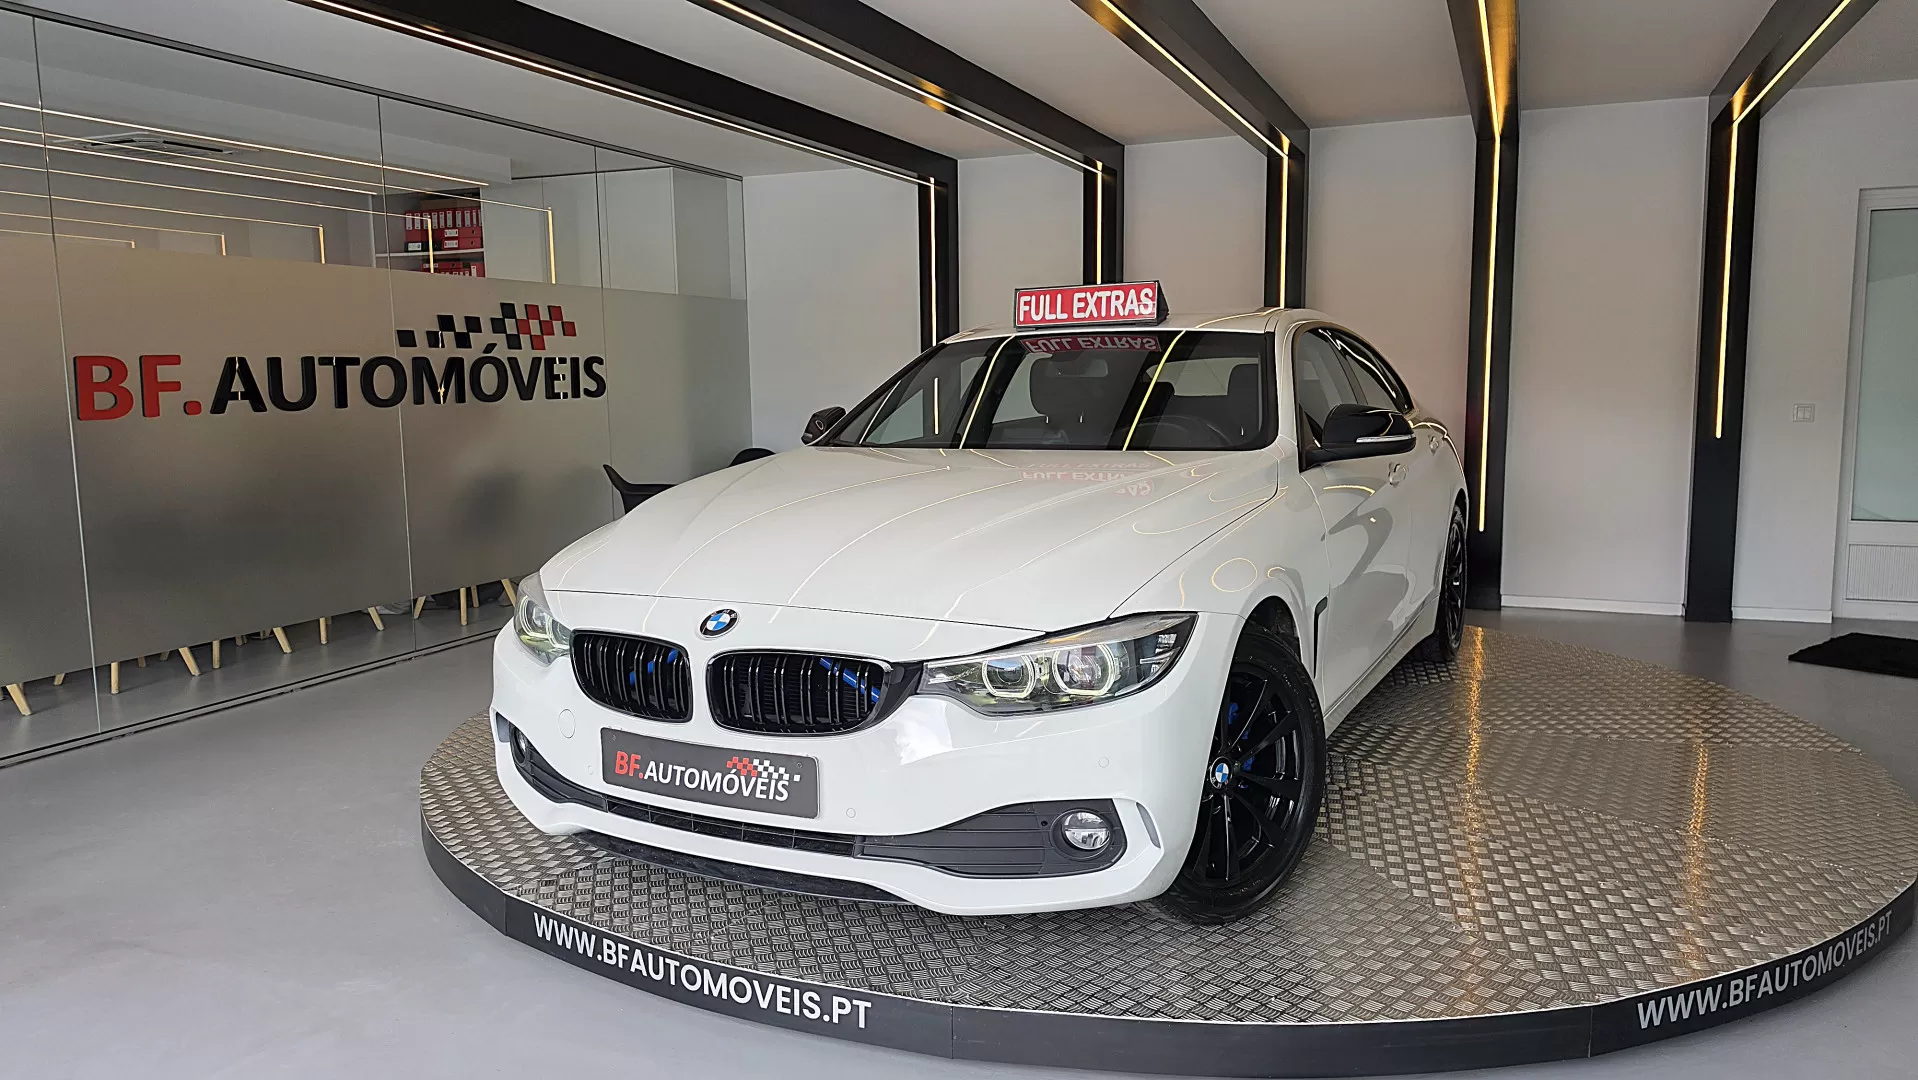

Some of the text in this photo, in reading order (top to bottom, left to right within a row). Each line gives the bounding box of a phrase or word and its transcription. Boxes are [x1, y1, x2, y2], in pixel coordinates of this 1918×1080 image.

[1019, 287, 1154, 322] FULL EXTRAS
[73, 342, 607, 421] BF.AUTOMÓVEIS
[614, 750, 790, 803] BF.AUTOMÓVEIS
[533, 911, 873, 1029] WWW.BFAUTOMOVEIS.PT
[1637, 909, 1893, 1030] WWW.BFAUTOMOVEIS.PT
